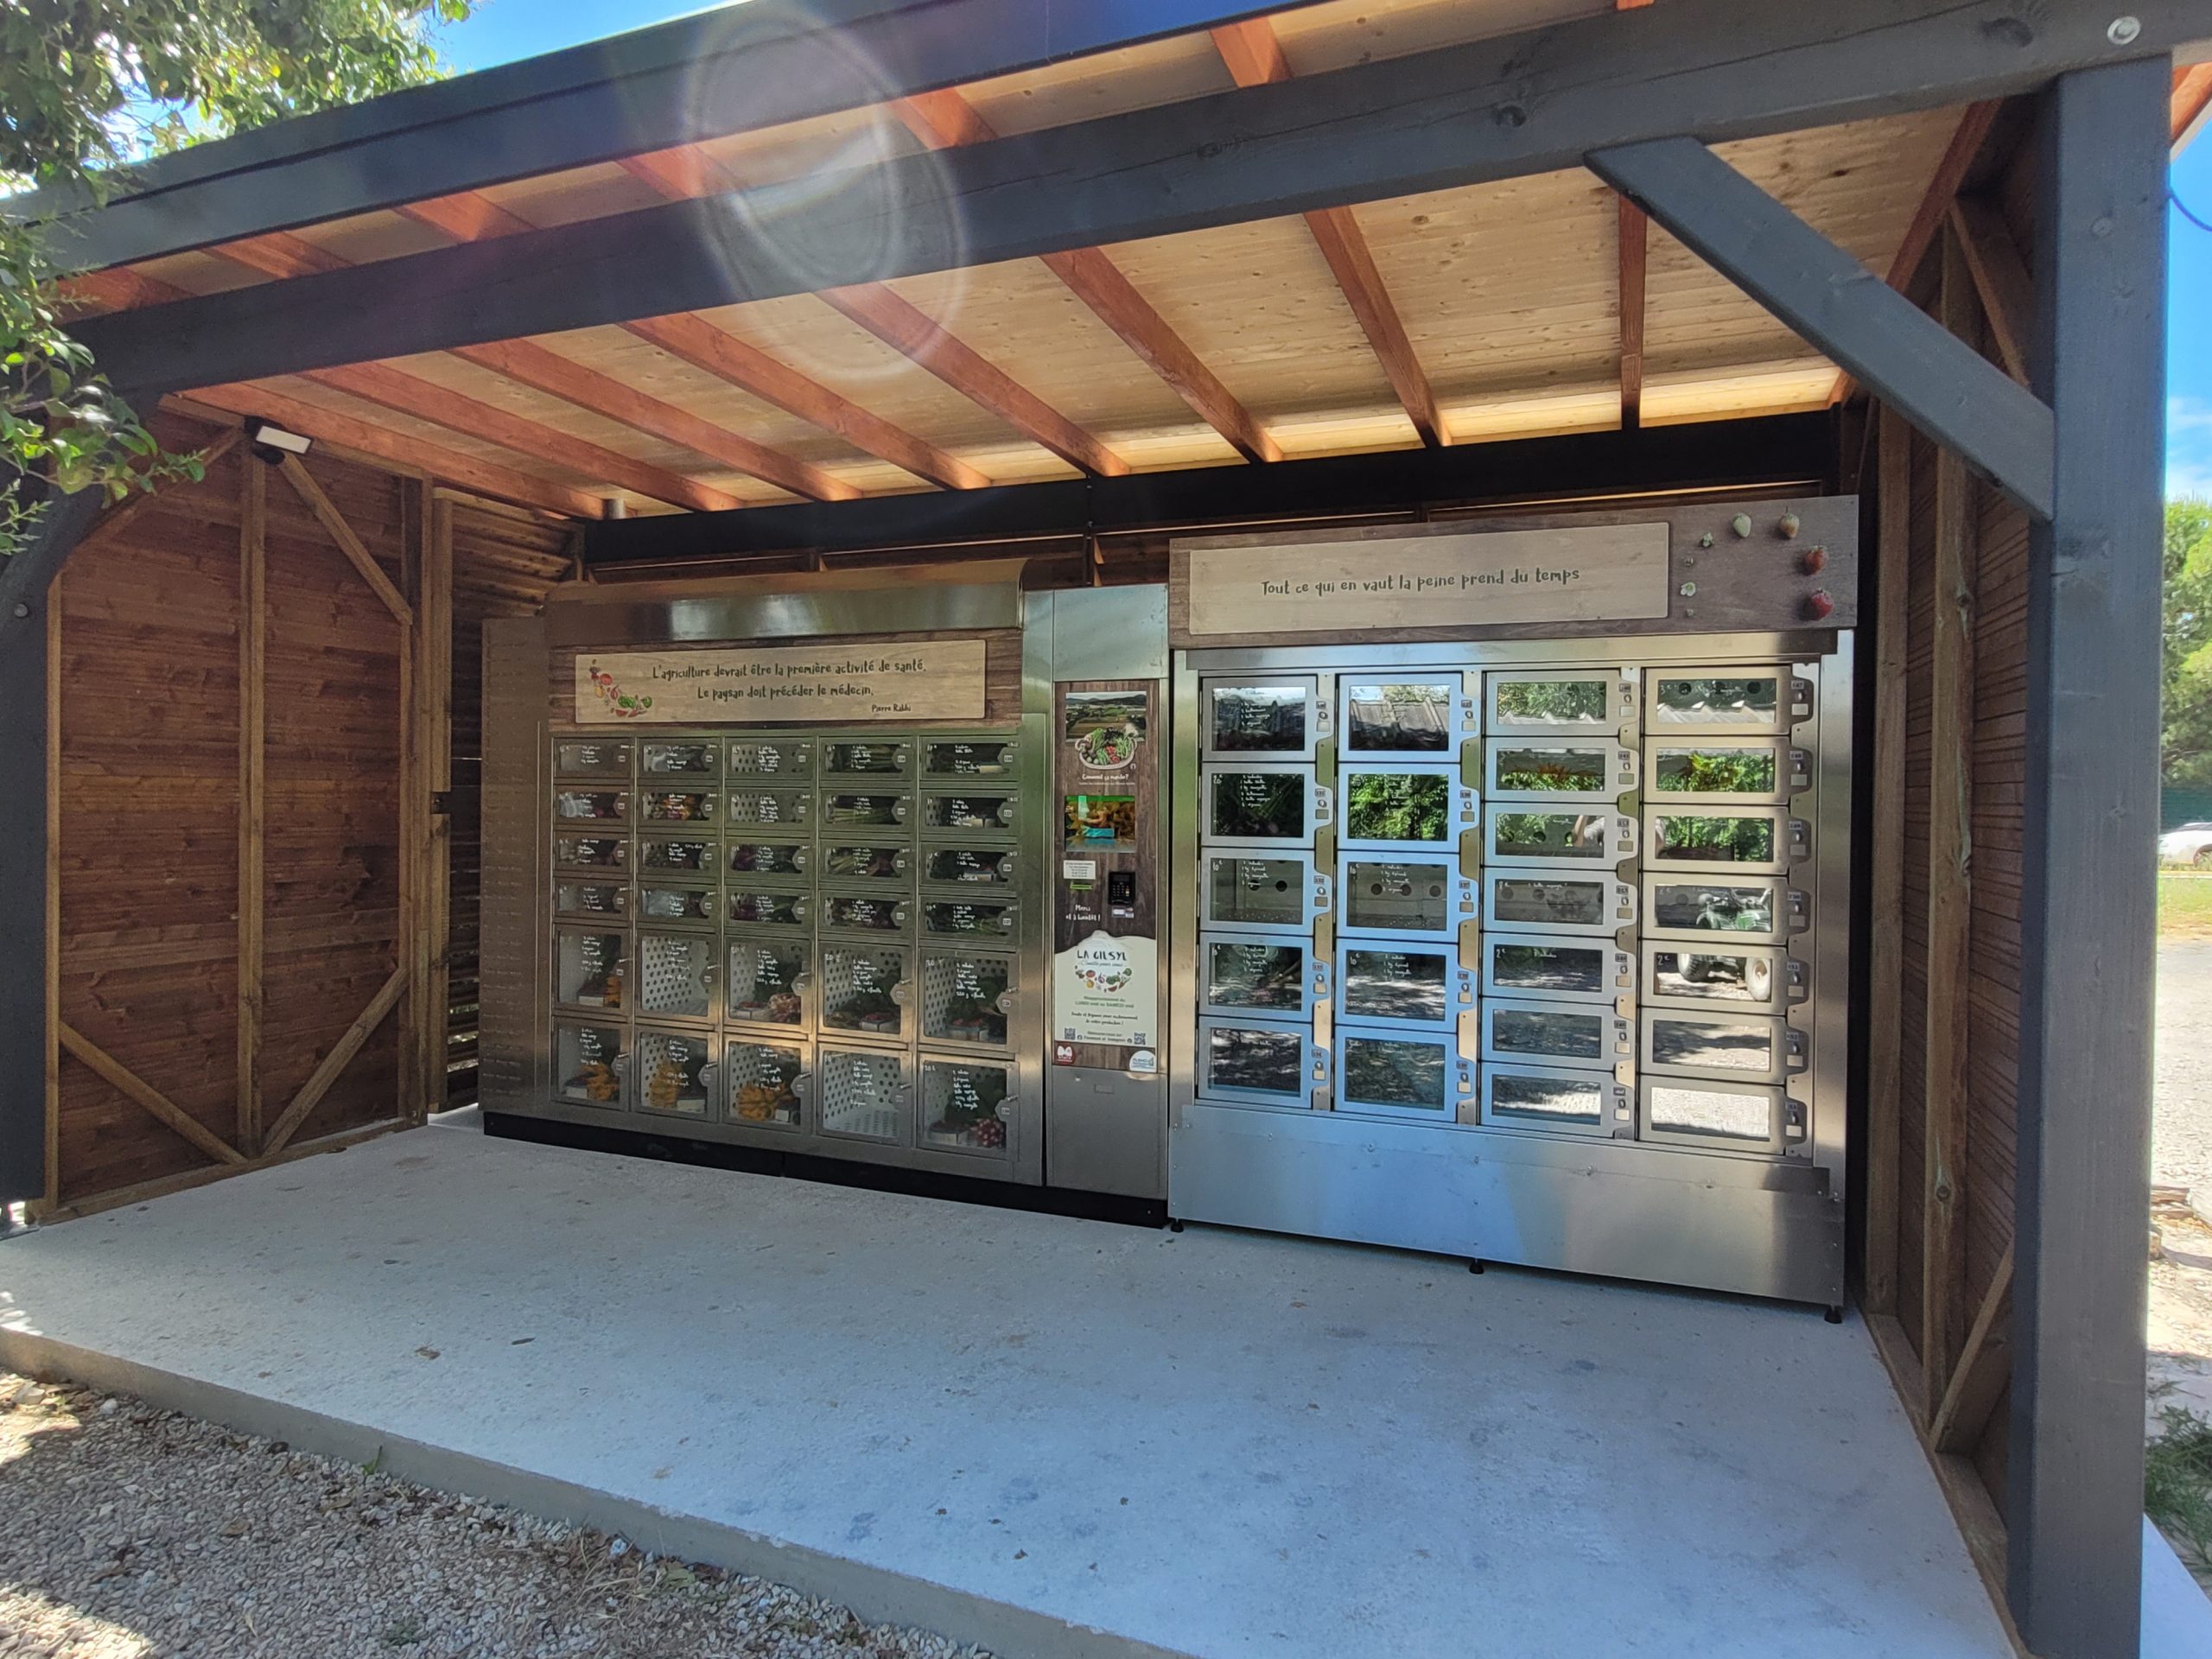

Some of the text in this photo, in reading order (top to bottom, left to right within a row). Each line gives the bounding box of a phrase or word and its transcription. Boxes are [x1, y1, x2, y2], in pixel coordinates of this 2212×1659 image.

[1262, 567, 1580, 596] Tout ce qui en vaut la peine prend du temps
[652, 658, 926, 681] L'agriculture devrait être la première activité de santé.
[697, 683, 874, 702] Le paysan doit précéder le médecin.
[1077, 950, 1090, 959] LA
